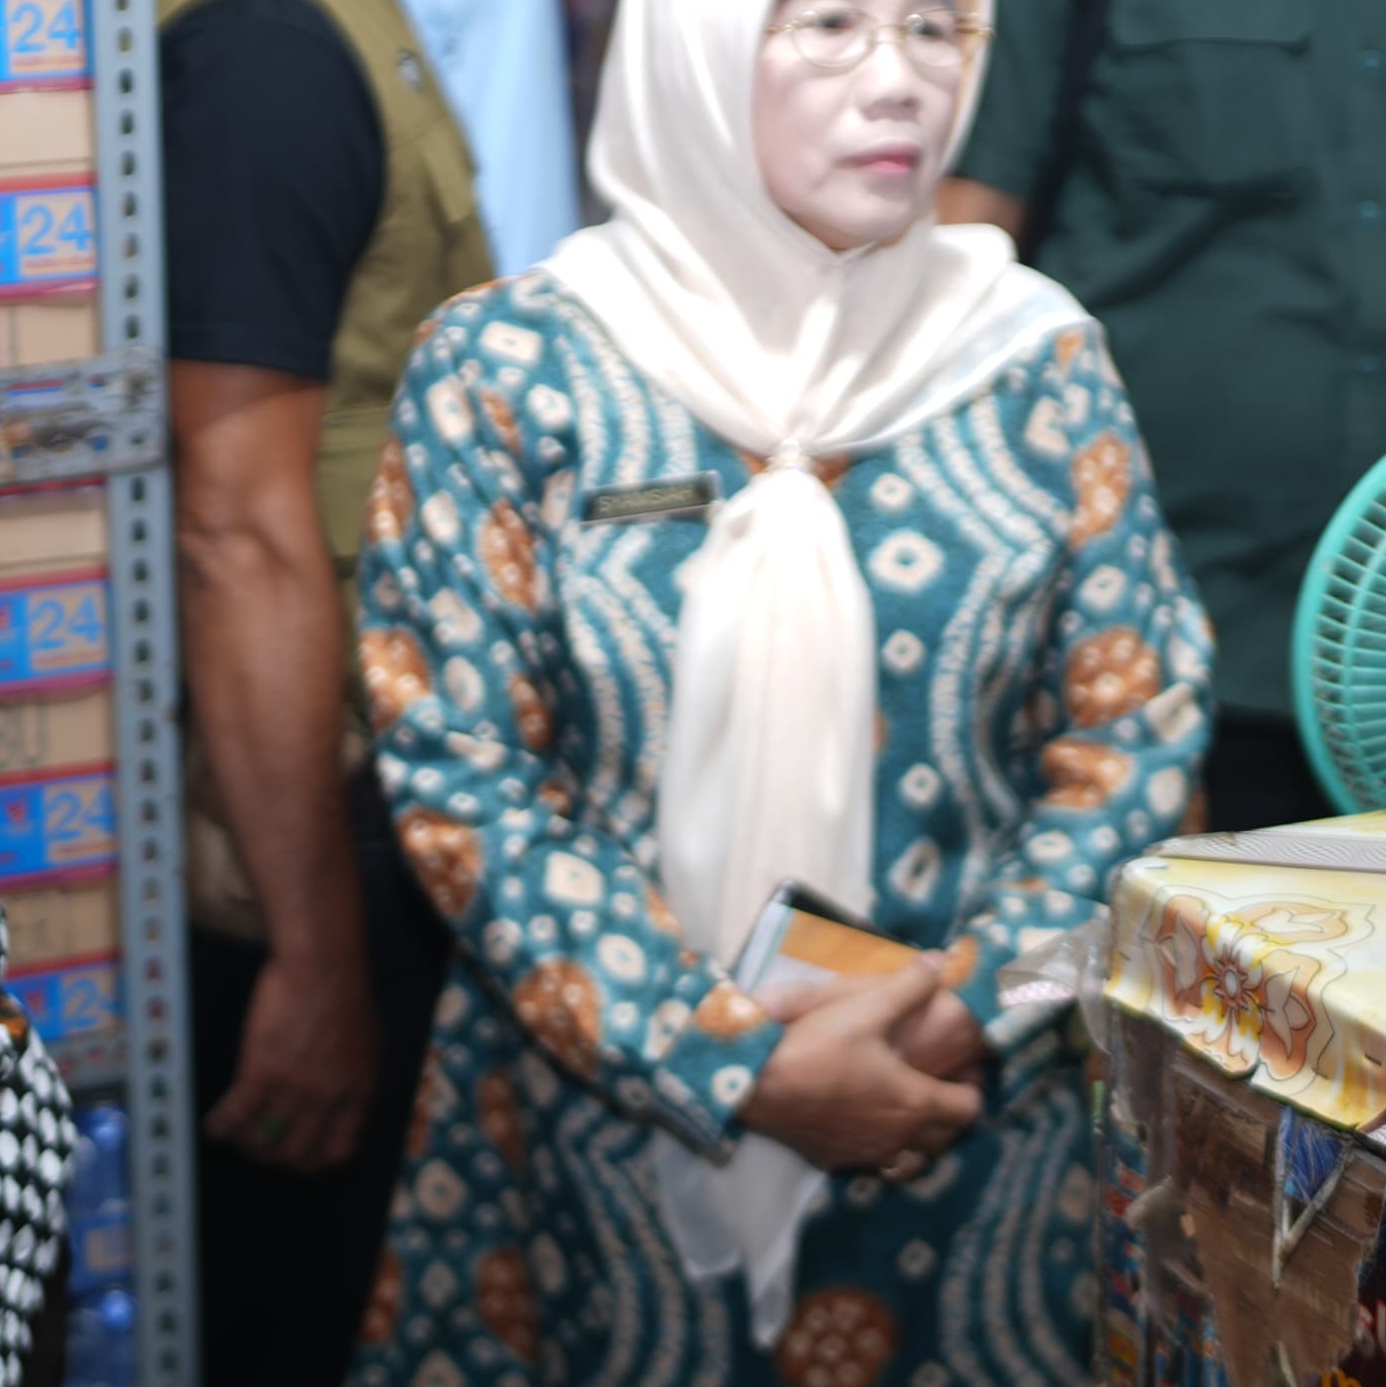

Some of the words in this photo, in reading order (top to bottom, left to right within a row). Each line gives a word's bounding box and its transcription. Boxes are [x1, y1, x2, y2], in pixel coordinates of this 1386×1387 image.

[12, 0, 82, 54] 24
[21, 201, 93, 255] 24
[32, 594, 105, 651] 24
[44, 787, 118, 842] 24
